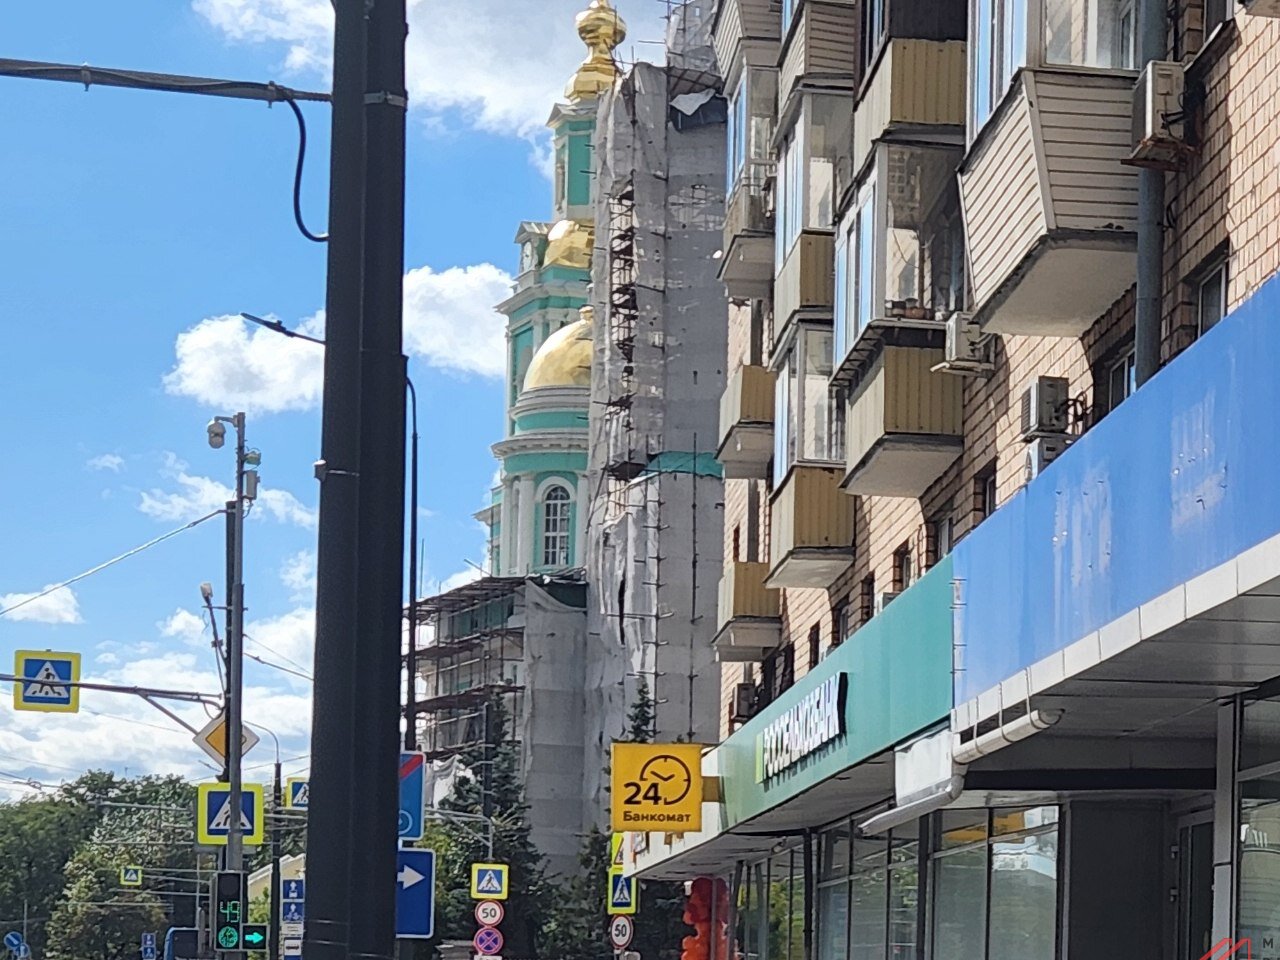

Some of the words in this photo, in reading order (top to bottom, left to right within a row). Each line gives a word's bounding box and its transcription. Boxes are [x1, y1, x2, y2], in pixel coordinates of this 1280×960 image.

[623, 782, 662, 805] 24
[623, 811, 691, 822] Банкомат
[220, 900, 240, 922] 49
[482, 908, 497, 918] 50
[614, 924, 627, 937] 50
